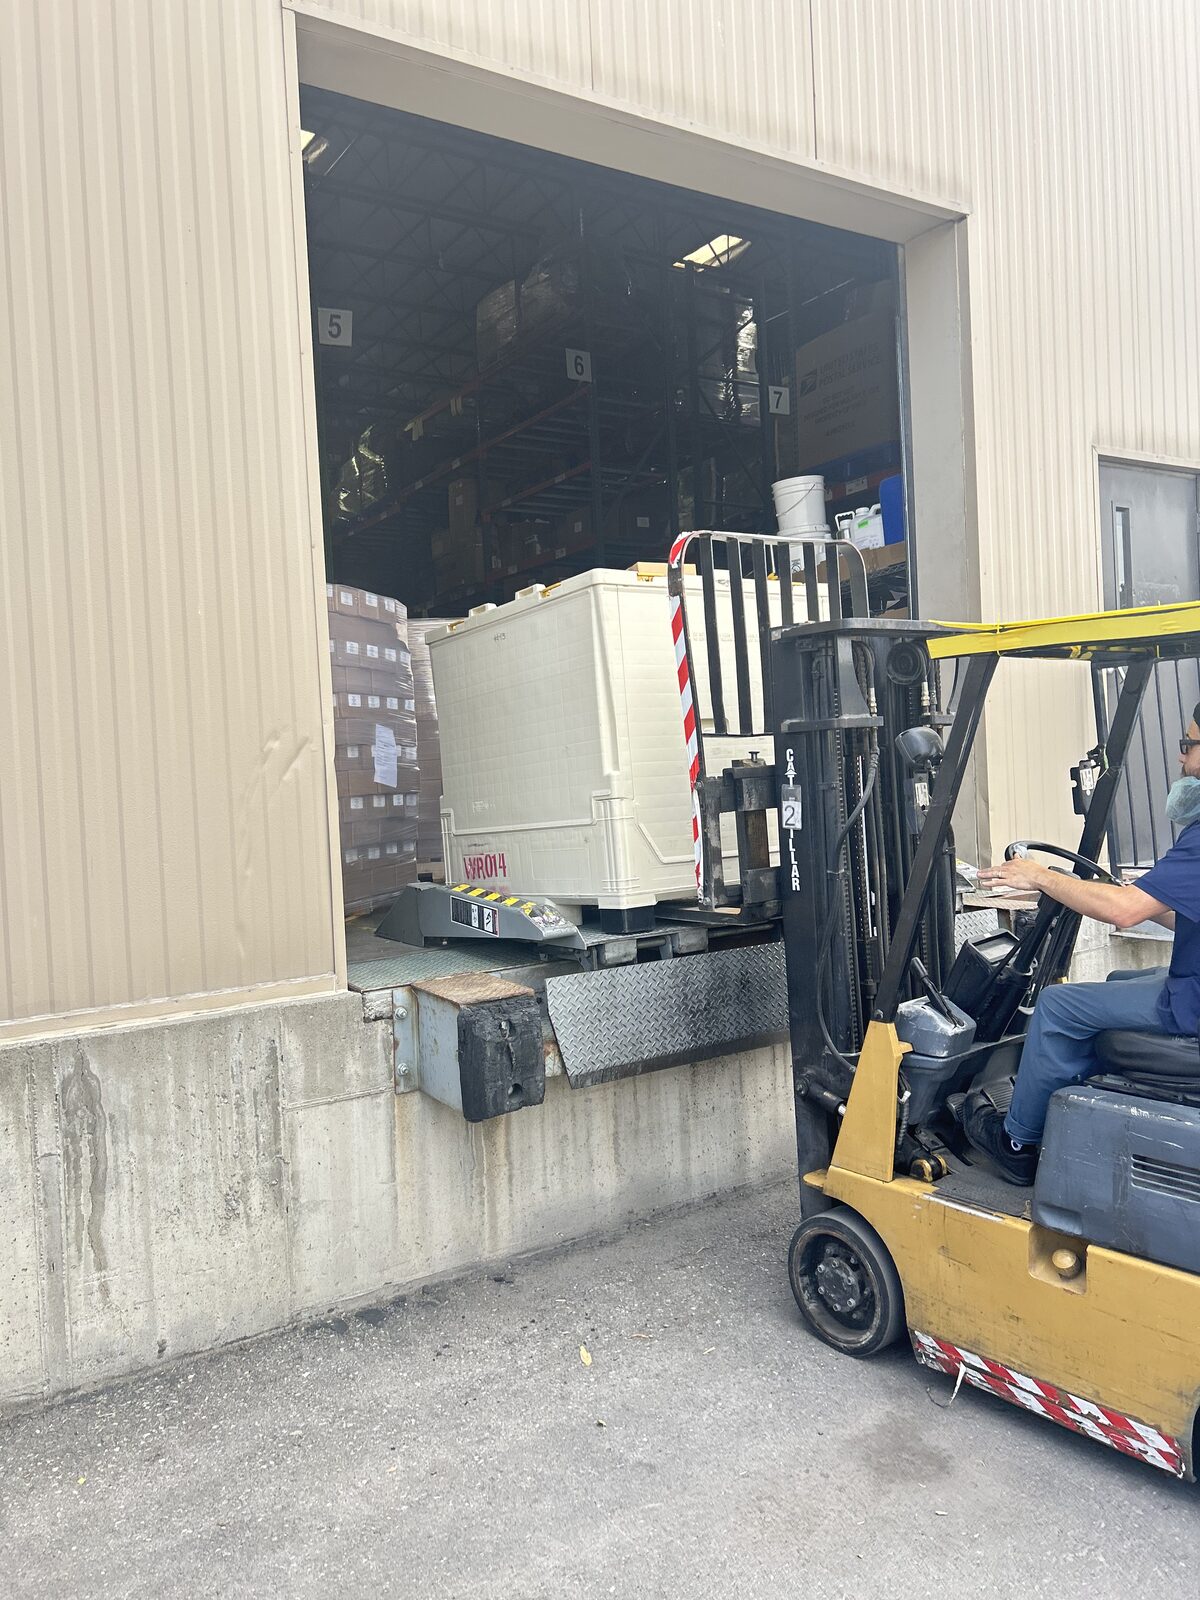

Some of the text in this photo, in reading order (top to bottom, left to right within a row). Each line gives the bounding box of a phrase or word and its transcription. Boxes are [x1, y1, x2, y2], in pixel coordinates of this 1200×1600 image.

[327, 313, 342, 339] 5
[573, 355, 585, 377] 6
[772, 390, 784, 410] 7
[784, 804, 796, 827] 2
[784, 748, 801, 892] CATILLAR
[463, 852, 507, 881] WR014
